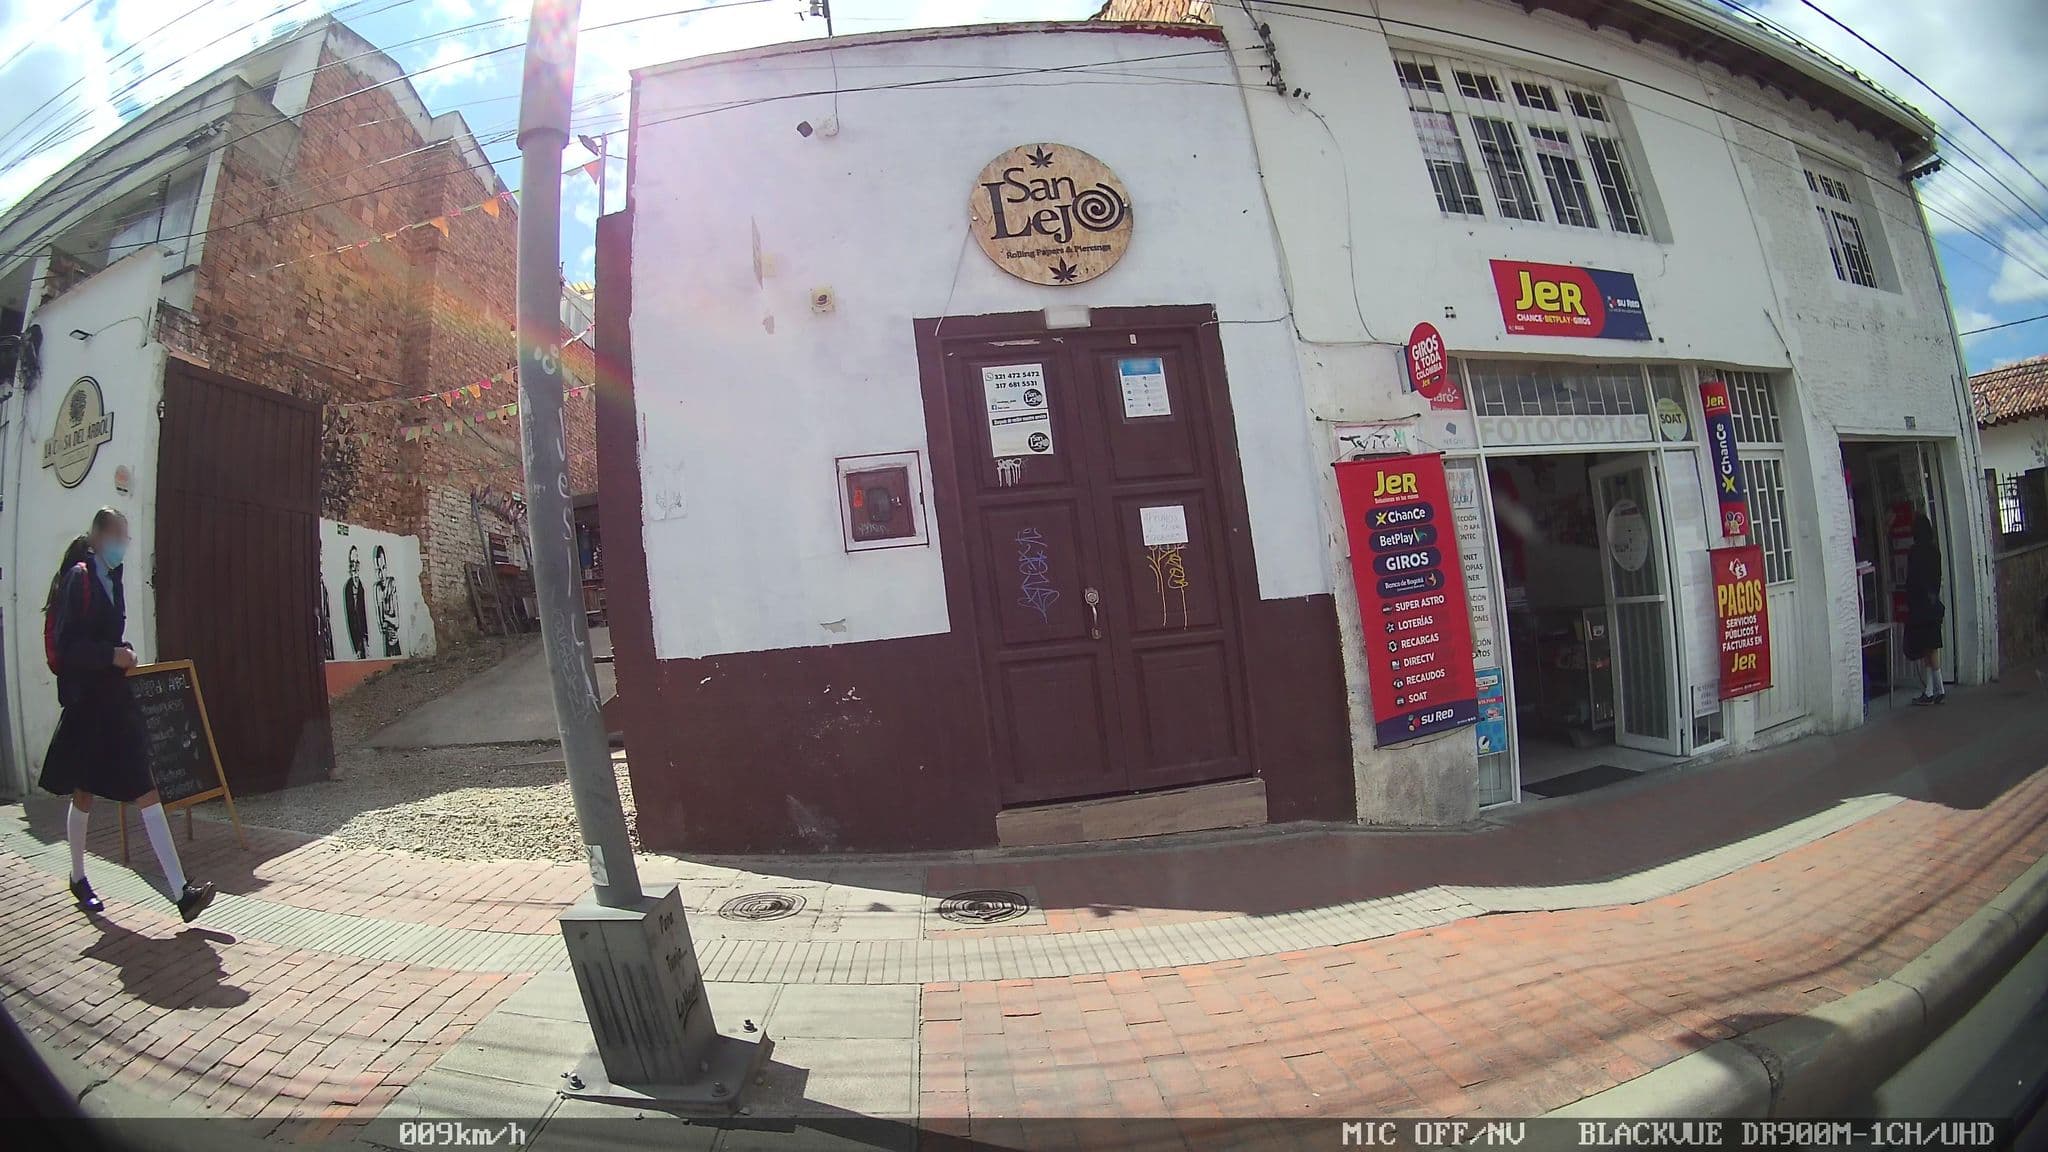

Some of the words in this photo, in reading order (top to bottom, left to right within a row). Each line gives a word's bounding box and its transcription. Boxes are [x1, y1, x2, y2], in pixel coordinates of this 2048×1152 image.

[1003, 167, 1076, 203] San
[1006, 250, 1036, 260] Rolling
[1036, 247, 1065, 257] Papers
[1516, 314, 1543, 323] CHANCE
[1412, 334, 1438, 360] GIROS
[1415, 361, 1421, 372] A
[1421, 350, 1441, 369] TODA
[1416, 362, 1443, 380] COLOMBIA
[1660, 412, 1682, 425] SOAT
[1480, 415, 1648, 445] FOTOCOPIAS
[1379, 530, 1414, 547] BetPlay
[1385, 551, 1429, 571] GIROS
[1395, 599, 1420, 612] SUPER
[1421, 595, 1445, 607] ASTRO
[1717, 578, 1763, 618] PAGOS
[1398, 615, 1434, 631] LOTERÍAS
[1726, 614, 1757, 629] SERVICIOS
[1400, 632, 1440, 649] RECARGAS
[1725, 628, 1755, 641] PÚBLICOS
[1753, 625, 1759, 634] Y
[1722, 637, 1754, 652] FACTURAS
[1754, 635, 1763, 646] EN
[1403, 652, 1435, 667] DIRECTV
[1406, 669, 1446, 686] RECAUDOS
[1408, 691, 1428, 703] SOAT
[1421, 713, 1435, 725] SU
